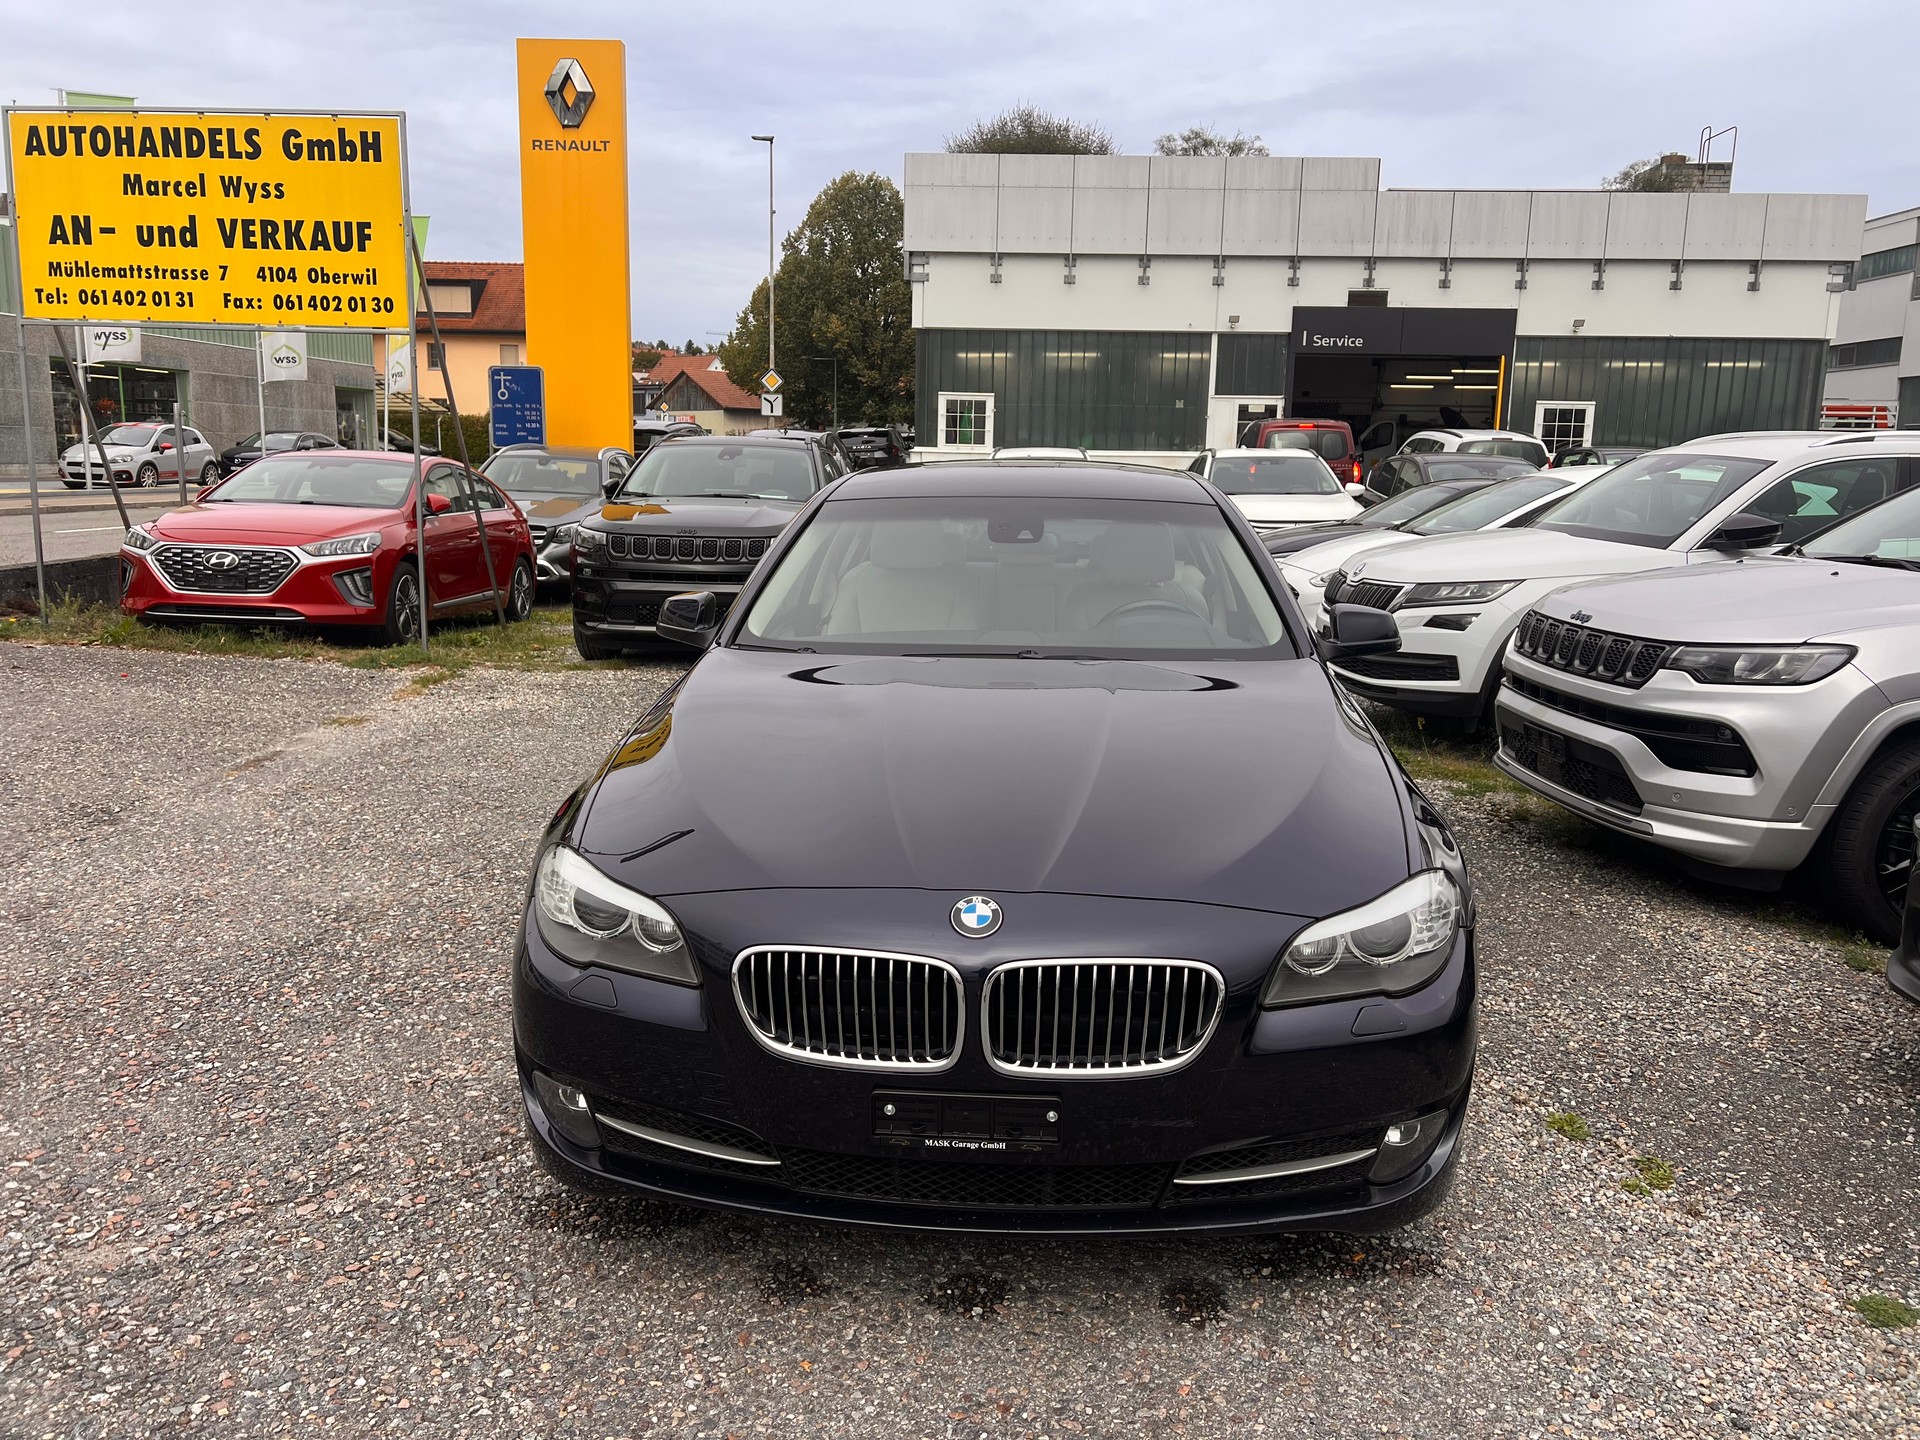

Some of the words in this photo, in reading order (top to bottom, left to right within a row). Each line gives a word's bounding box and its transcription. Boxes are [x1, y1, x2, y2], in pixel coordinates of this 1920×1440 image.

[25, 125, 262, 160] AUTOHANDELS
[282, 128, 382, 162] GmbH
[532, 139, 610, 152] RENAULT
[123, 173, 206, 197] Marcel
[219, 175, 285, 203] Wyss
[136, 215, 198, 248] und
[216, 218, 372, 252] VERKAUF
[48, 260, 209, 281] Mühlemattstrasse
[218, 265, 228, 281] 7
[256, 266, 297, 283] 4104
[307, 266, 378, 285] Oberwil
[34, 287, 68, 304] Tel:
[223, 293, 262, 310] Fax:
[1313, 335, 1364, 347] Service
[1570, 610, 1593, 624] Jeep
[924, 1139, 951, 1147] MASK
[952, 1140, 979, 1149] Garage
[981, 1141, 1006, 1149] GmbH
